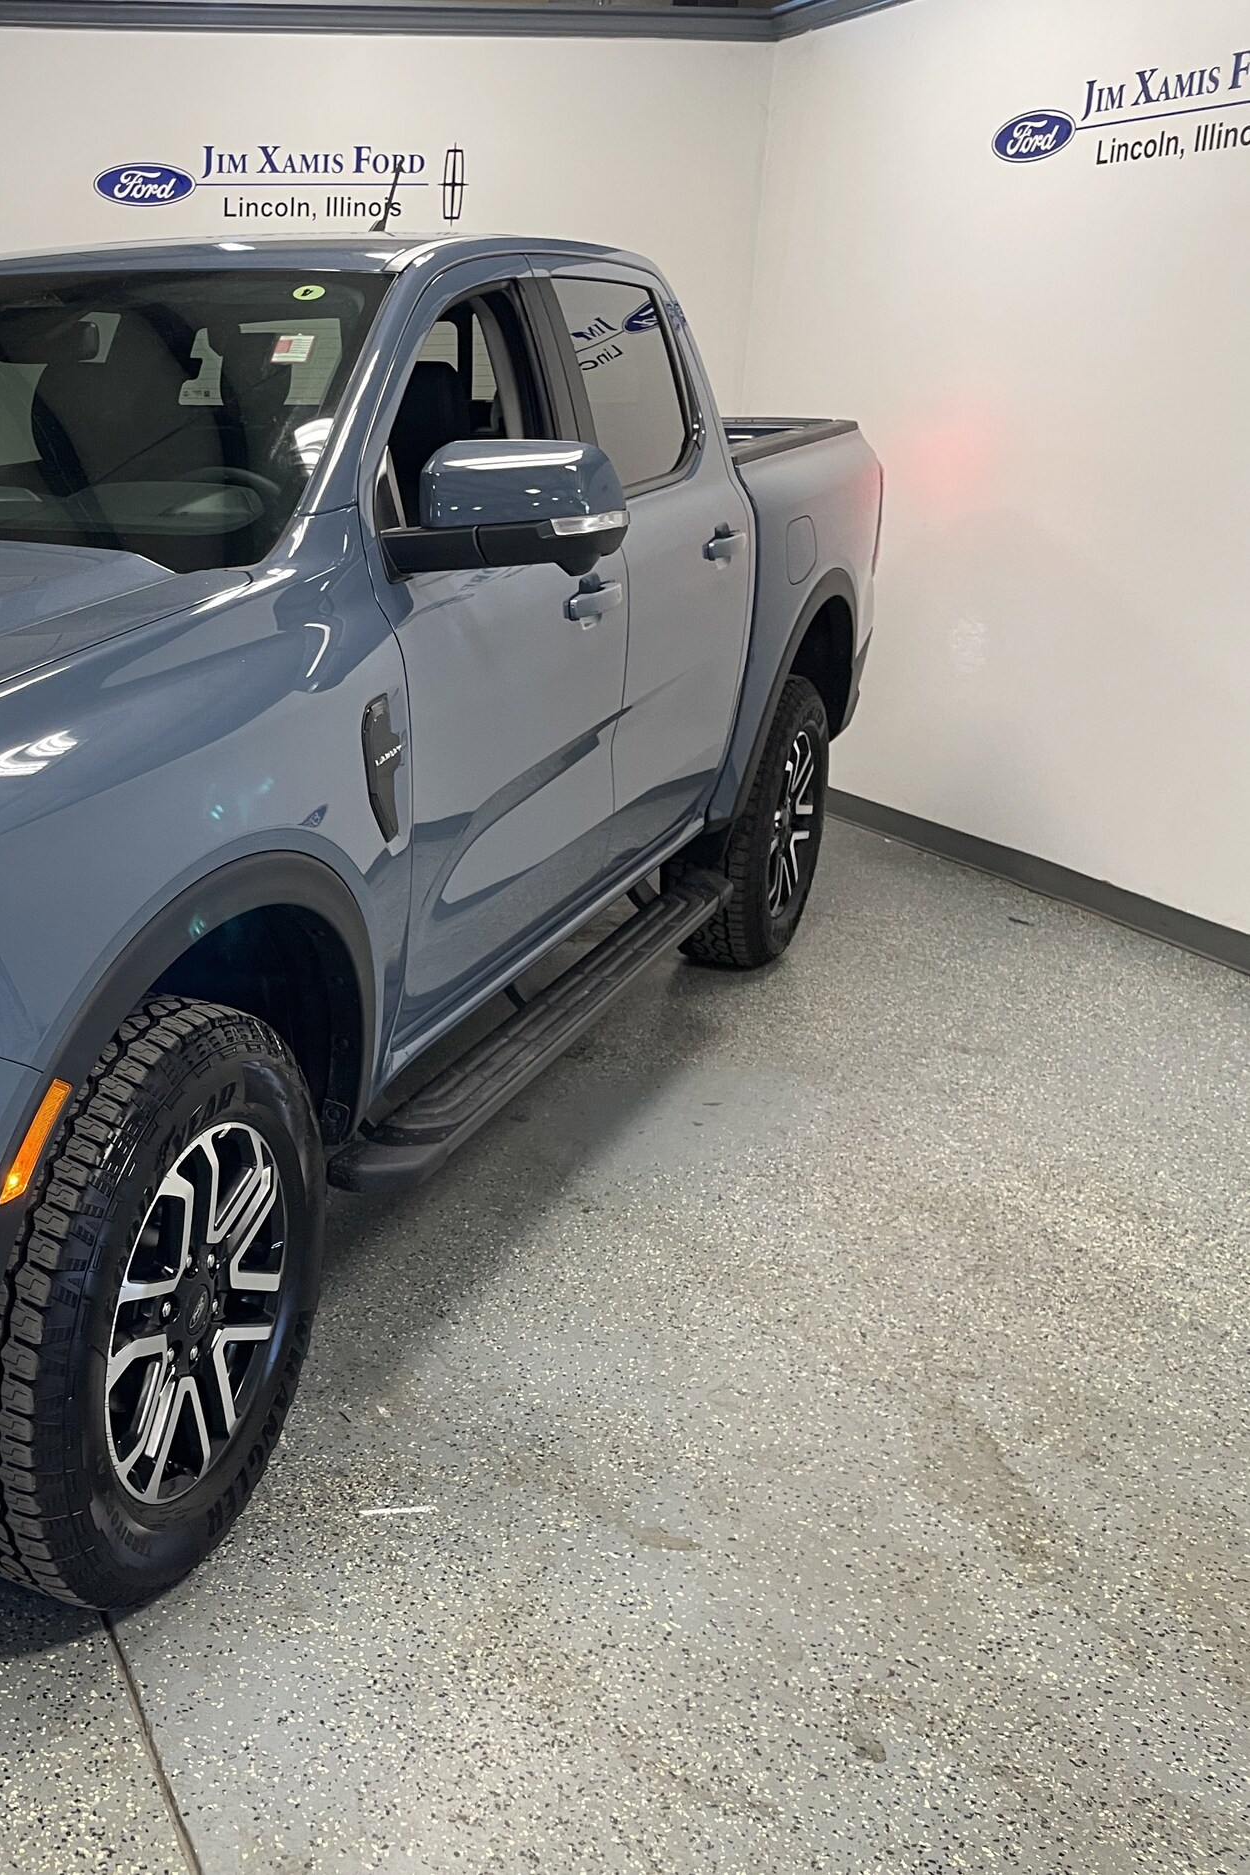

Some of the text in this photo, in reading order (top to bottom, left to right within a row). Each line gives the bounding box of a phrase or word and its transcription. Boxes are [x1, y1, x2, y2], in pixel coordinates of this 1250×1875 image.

[1080, 79, 1126, 121] JIM
[1131, 68, 1220, 107] XAMIS
[1006, 119, 1061, 155] Ford
[1096, 121, 1250, 165] Lincoln, Illino
[201, 145, 425, 178] JIM XAMIS FORD
[113, 170, 175, 199] Ford
[224, 197, 317, 221] Lincoln,
